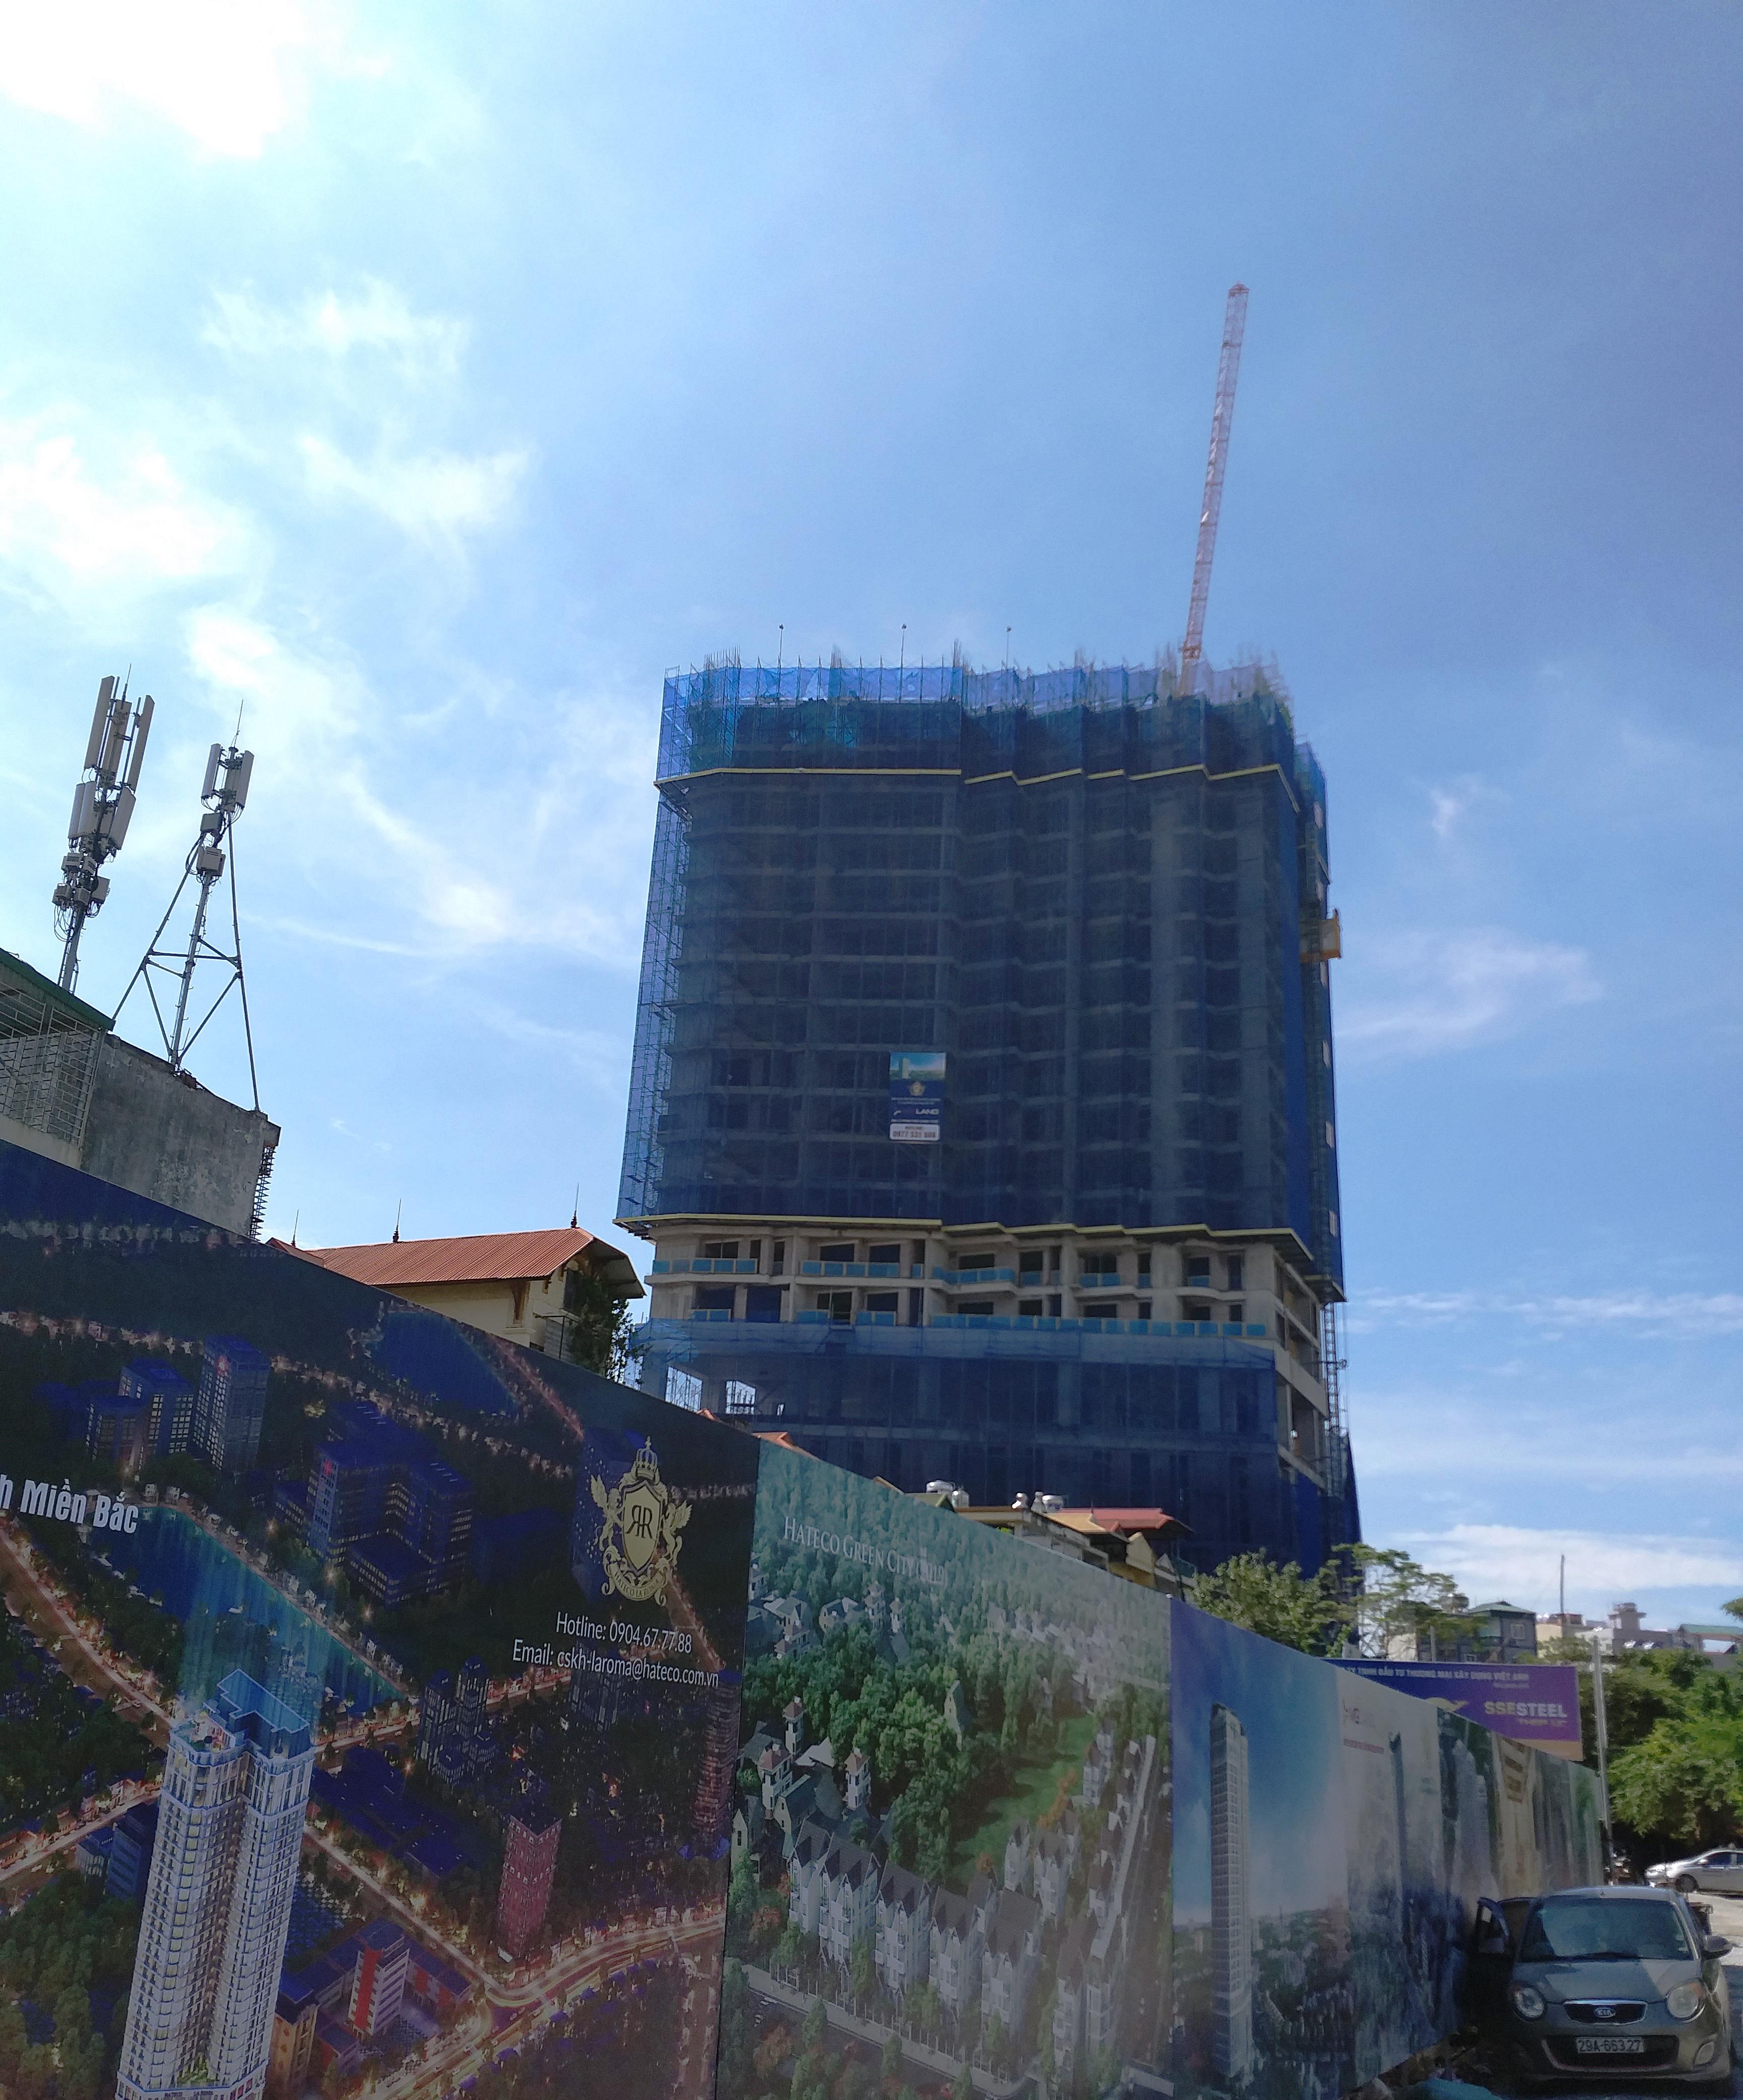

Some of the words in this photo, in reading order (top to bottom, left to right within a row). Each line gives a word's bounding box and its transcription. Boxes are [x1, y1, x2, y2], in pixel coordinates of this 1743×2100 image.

[20, 1478, 87, 1524] Miền
[93, 1491, 139, 1534] Bắc
[784, 1515, 840, 1554] HATECO
[843, 1535, 884, 1570] GREEN
[887, 1549, 916, 1576] CITY
[556, 1611, 606, 1640] Hotline:
[609, 1620, 692, 1654] 0904.67.77.88
[513, 1639, 554, 1666] Email:
[557, 1647, 719, 1688] cskh-laroma@hateco.com.vn
